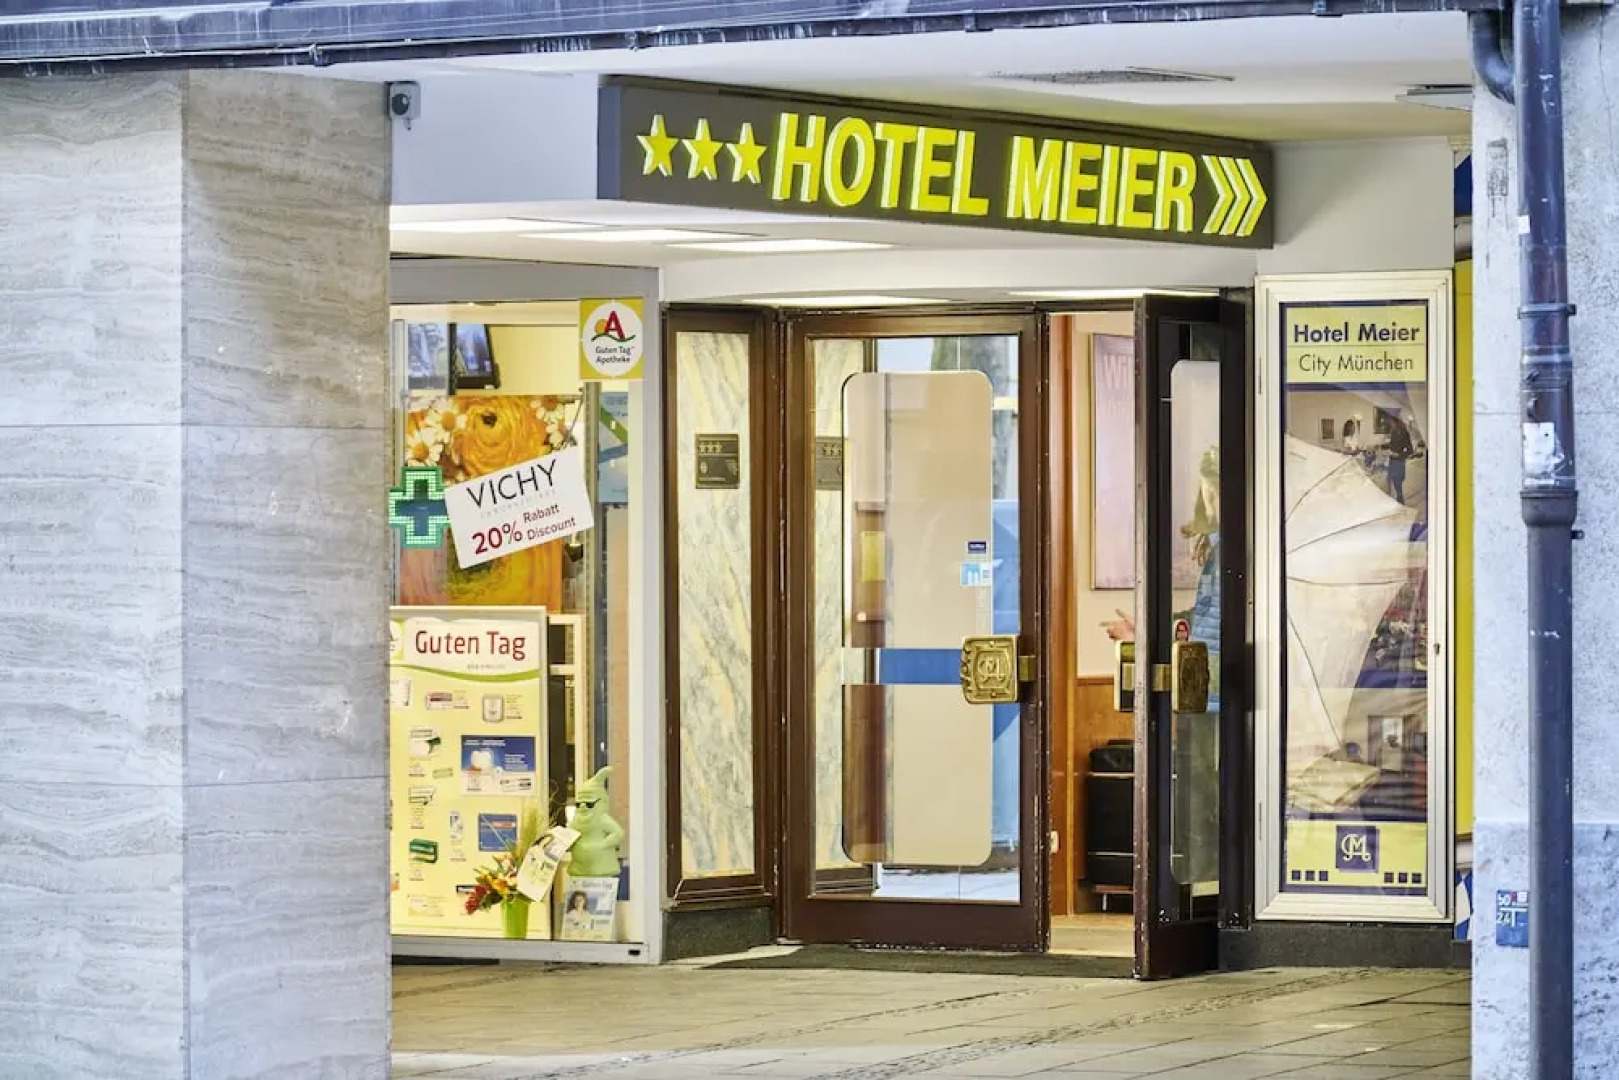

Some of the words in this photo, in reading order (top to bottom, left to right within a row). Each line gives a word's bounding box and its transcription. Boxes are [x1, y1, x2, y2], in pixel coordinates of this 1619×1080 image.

[771, 112, 989, 216] HOTEL
[1006, 134, 1195, 232] MEIER
[1293, 321, 1349, 343] Hotel
[1357, 321, 1420, 343] Meier
[595, 346, 618, 354] Guten
[595, 355, 631, 366] Apotheke
[1298, 353, 1332, 376] City
[1337, 350, 1414, 372] München
[465, 457, 557, 510] VICHY
[522, 503, 560, 524] Rabatt
[471, 520, 524, 556] 20%
[526, 516, 576, 541] Discount
[415, 629, 480, 655] Guten
[486, 630, 526, 662] Tag
